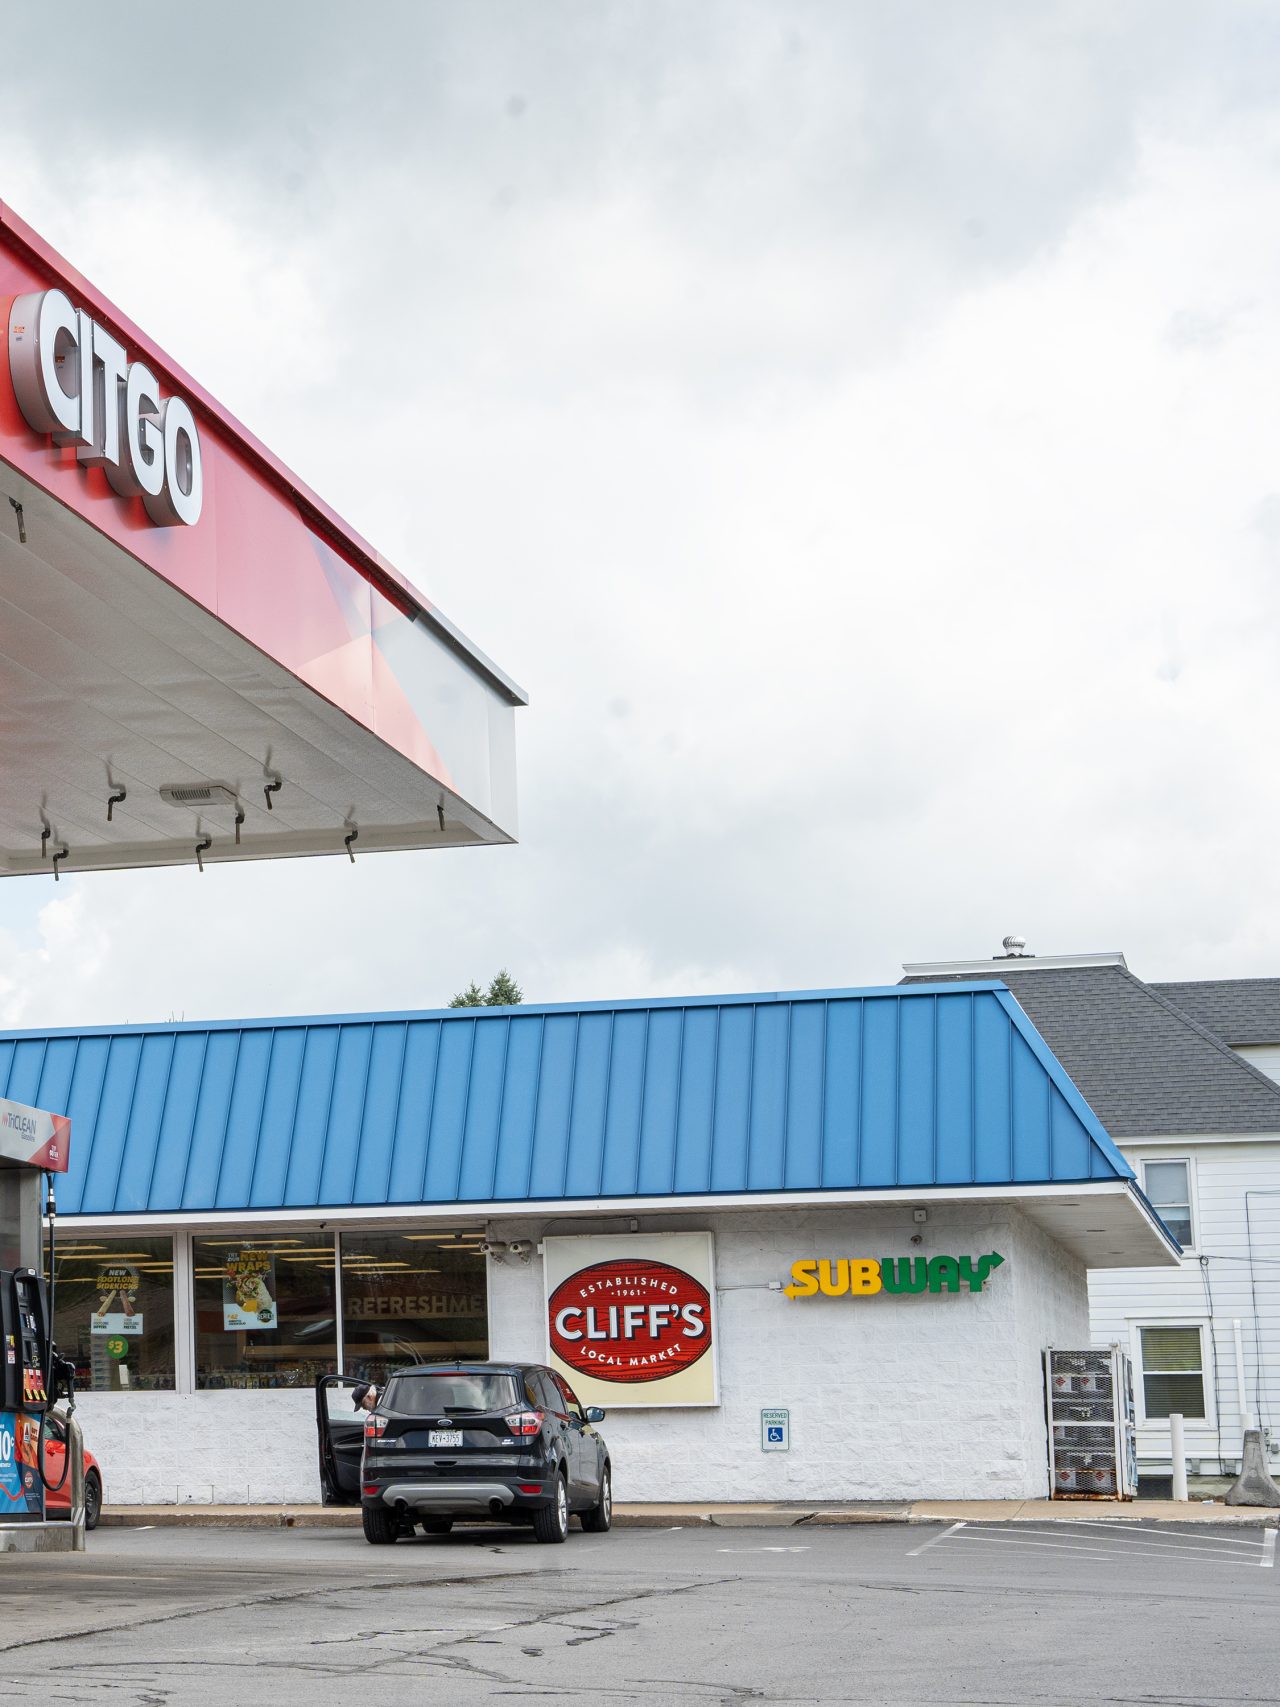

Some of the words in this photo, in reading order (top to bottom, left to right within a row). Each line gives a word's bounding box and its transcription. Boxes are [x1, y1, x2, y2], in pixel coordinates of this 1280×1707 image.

[38, 288, 203, 526] CITGO
[8, 1112, 37, 1135] TriCLEAN
[227, 1261, 271, 1271] WRAPS
[240, 1251, 268, 1261] NEW
[783, 1251, 1005, 1300] SUBWAY
[579, 1276, 678, 1298] ESTABLISHED
[617, 1289, 641, 1297] 1961
[348, 1295, 487, 1315] REFRESHME
[555, 1303, 706, 1341] CLIFF'S
[108, 1341, 123, 1354] $3
[581, 1346, 622, 1366] LOCAL
[629, 1343, 682, 1366] MARKET
